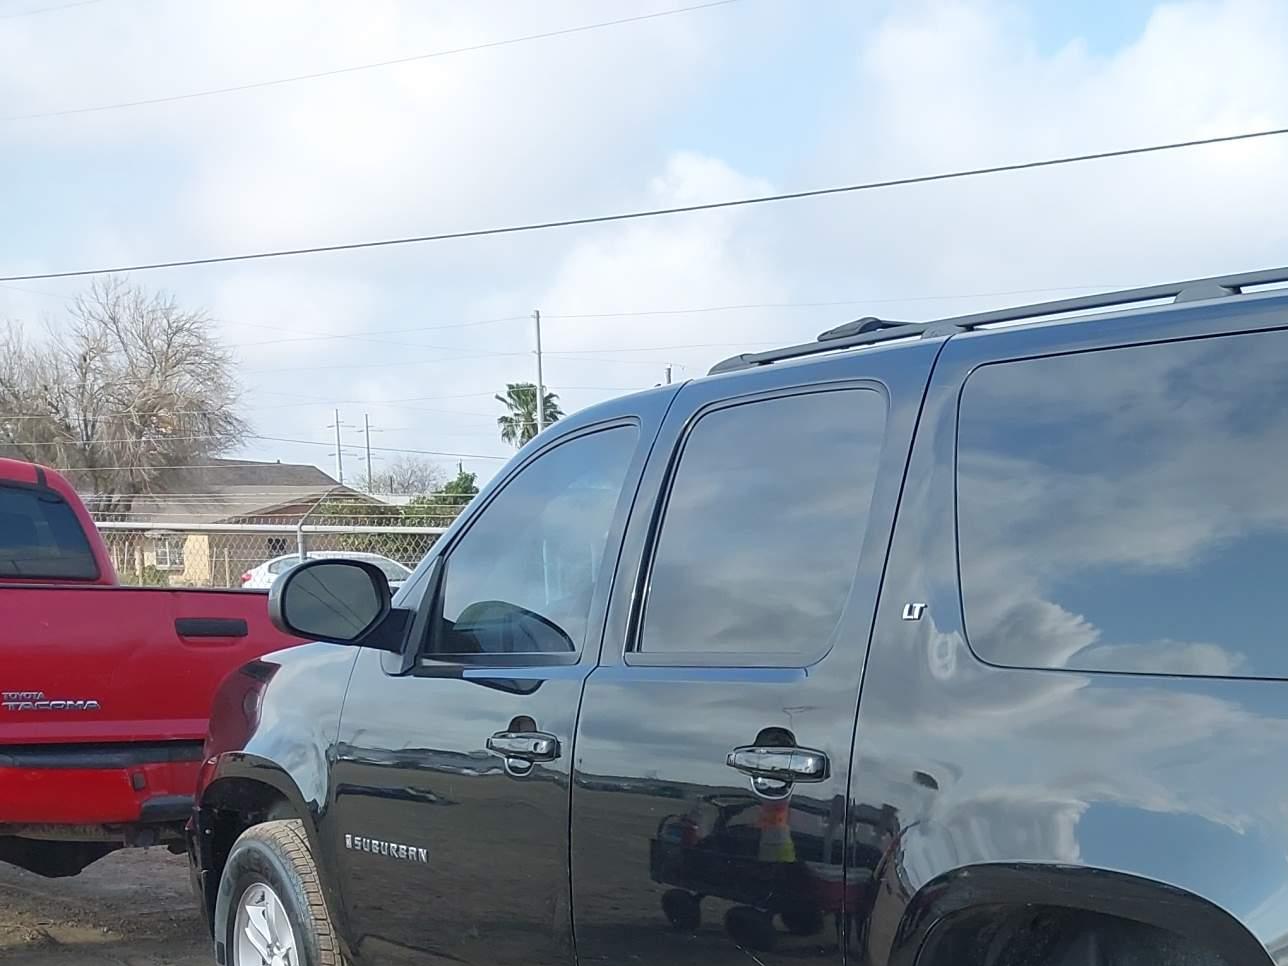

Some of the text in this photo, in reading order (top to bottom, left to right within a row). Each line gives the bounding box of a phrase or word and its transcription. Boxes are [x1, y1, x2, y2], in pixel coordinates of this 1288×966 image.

[902, 603, 926, 620] LT
[1, 691, 45, 700] TOYOTA
[1, 700, 101, 711] TACOMA
[353, 836, 428, 863] SUBURBAN
